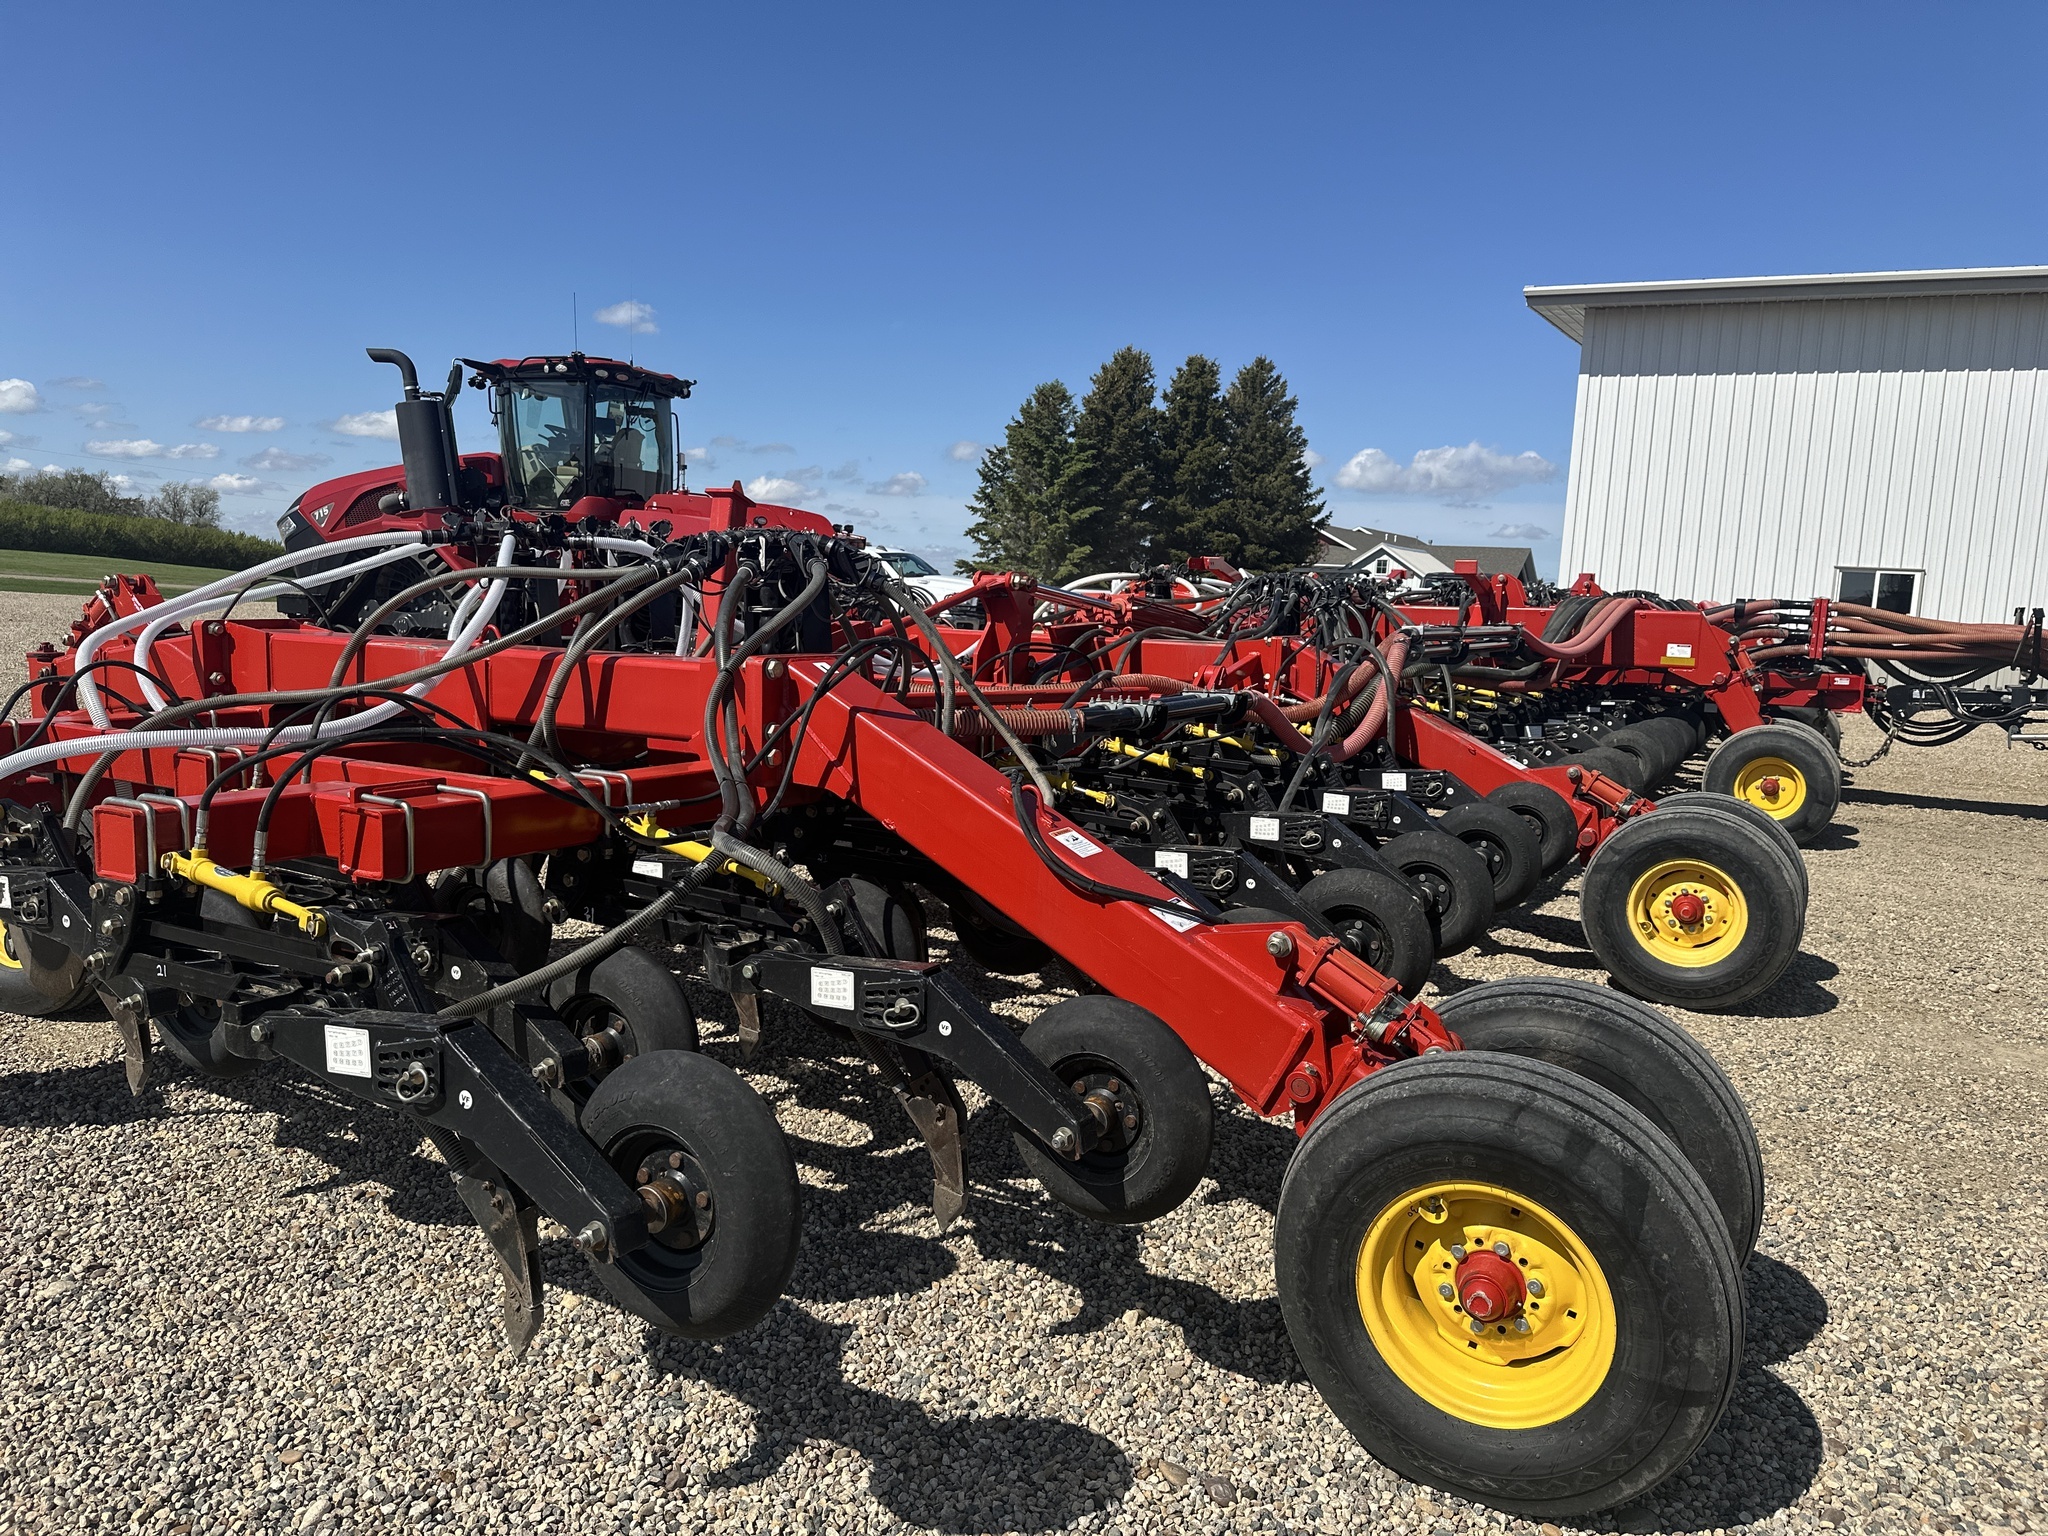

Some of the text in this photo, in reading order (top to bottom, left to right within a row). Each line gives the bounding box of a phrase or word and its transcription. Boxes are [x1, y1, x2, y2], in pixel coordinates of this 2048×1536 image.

[314, 505, 329, 520] 715
[385, 920, 398, 930] 21
[156, 964, 167, 977] 21
[461, 1094, 471, 1103] VF
